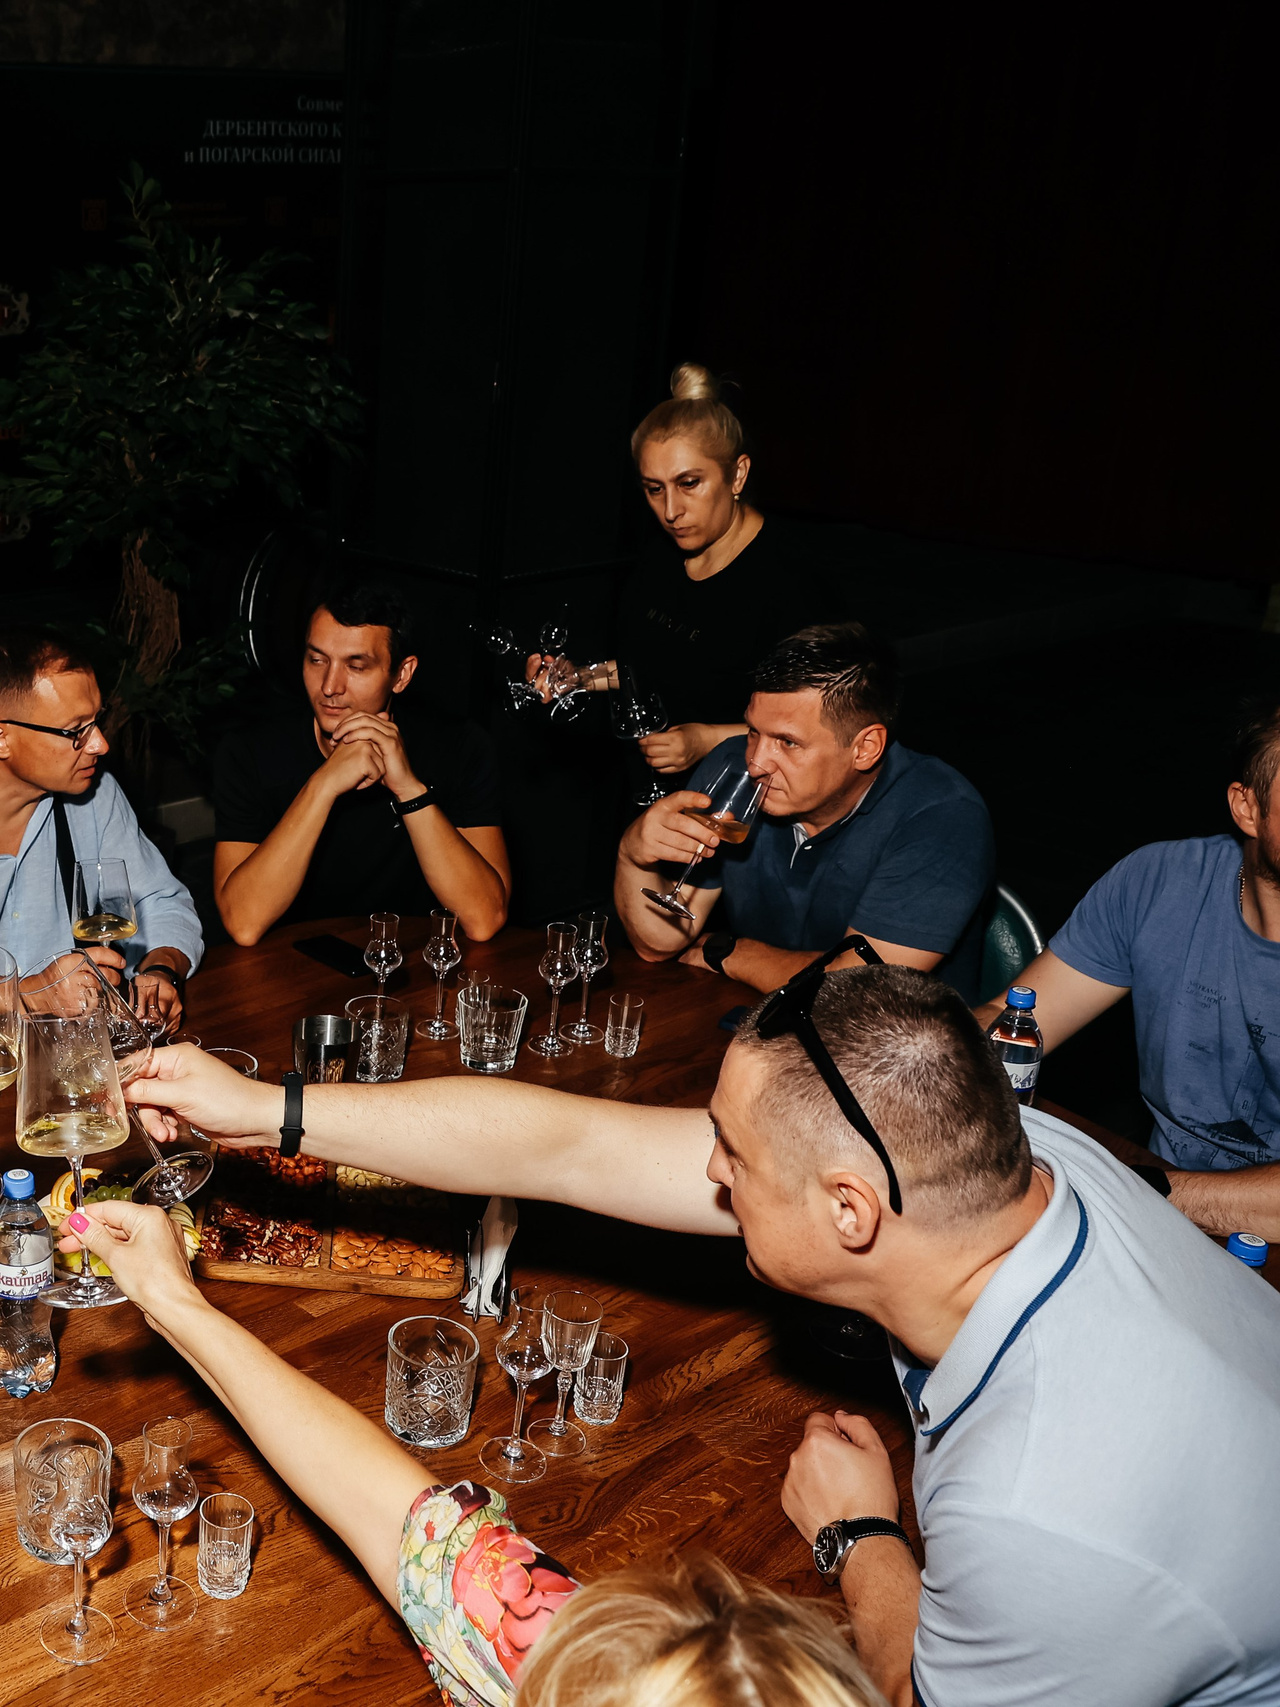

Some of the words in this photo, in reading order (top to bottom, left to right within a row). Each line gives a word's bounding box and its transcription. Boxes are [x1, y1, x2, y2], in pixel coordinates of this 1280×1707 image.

[202, 119, 328, 139] ДЕРБЕНТСКОГО
[184, 150, 194, 163] и
[198, 143, 294, 164] ПОГАРСКОЙ
